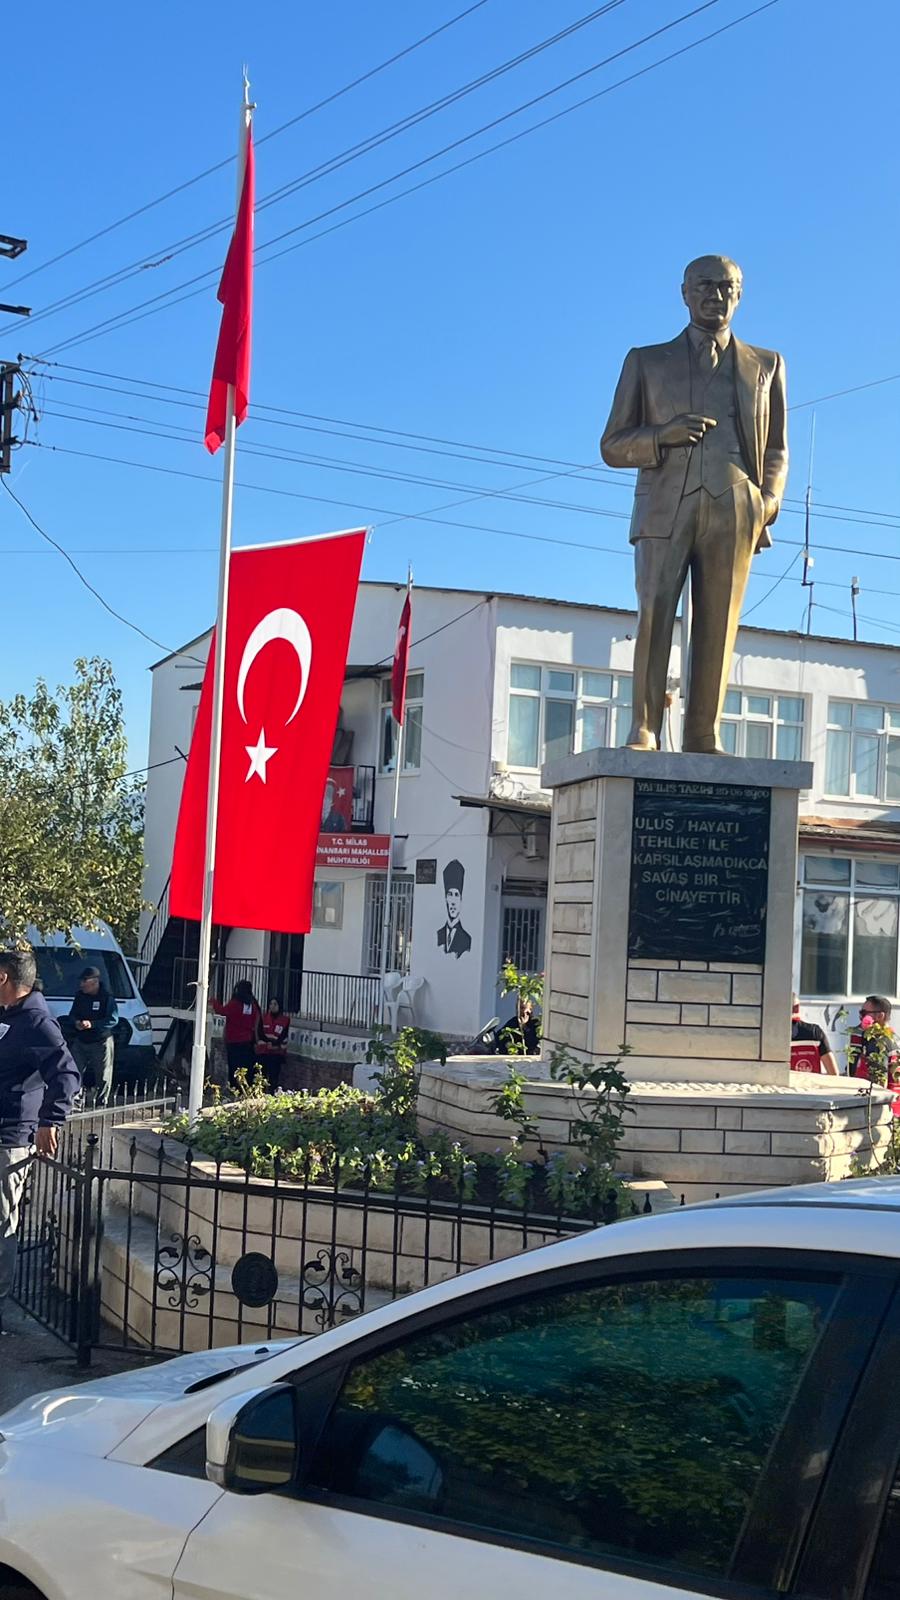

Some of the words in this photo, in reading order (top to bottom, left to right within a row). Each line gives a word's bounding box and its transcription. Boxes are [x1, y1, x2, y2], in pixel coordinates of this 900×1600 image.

[635, 818, 674, 831] ULUS
[688, 821, 739, 833] HAYATI
[638, 835, 699, 850] TEHLİKE
[642, 871, 688, 887] SAVAŞ
[694, 873, 718, 886] BİR
[655, 888, 741, 905] CİNAYETTİR
